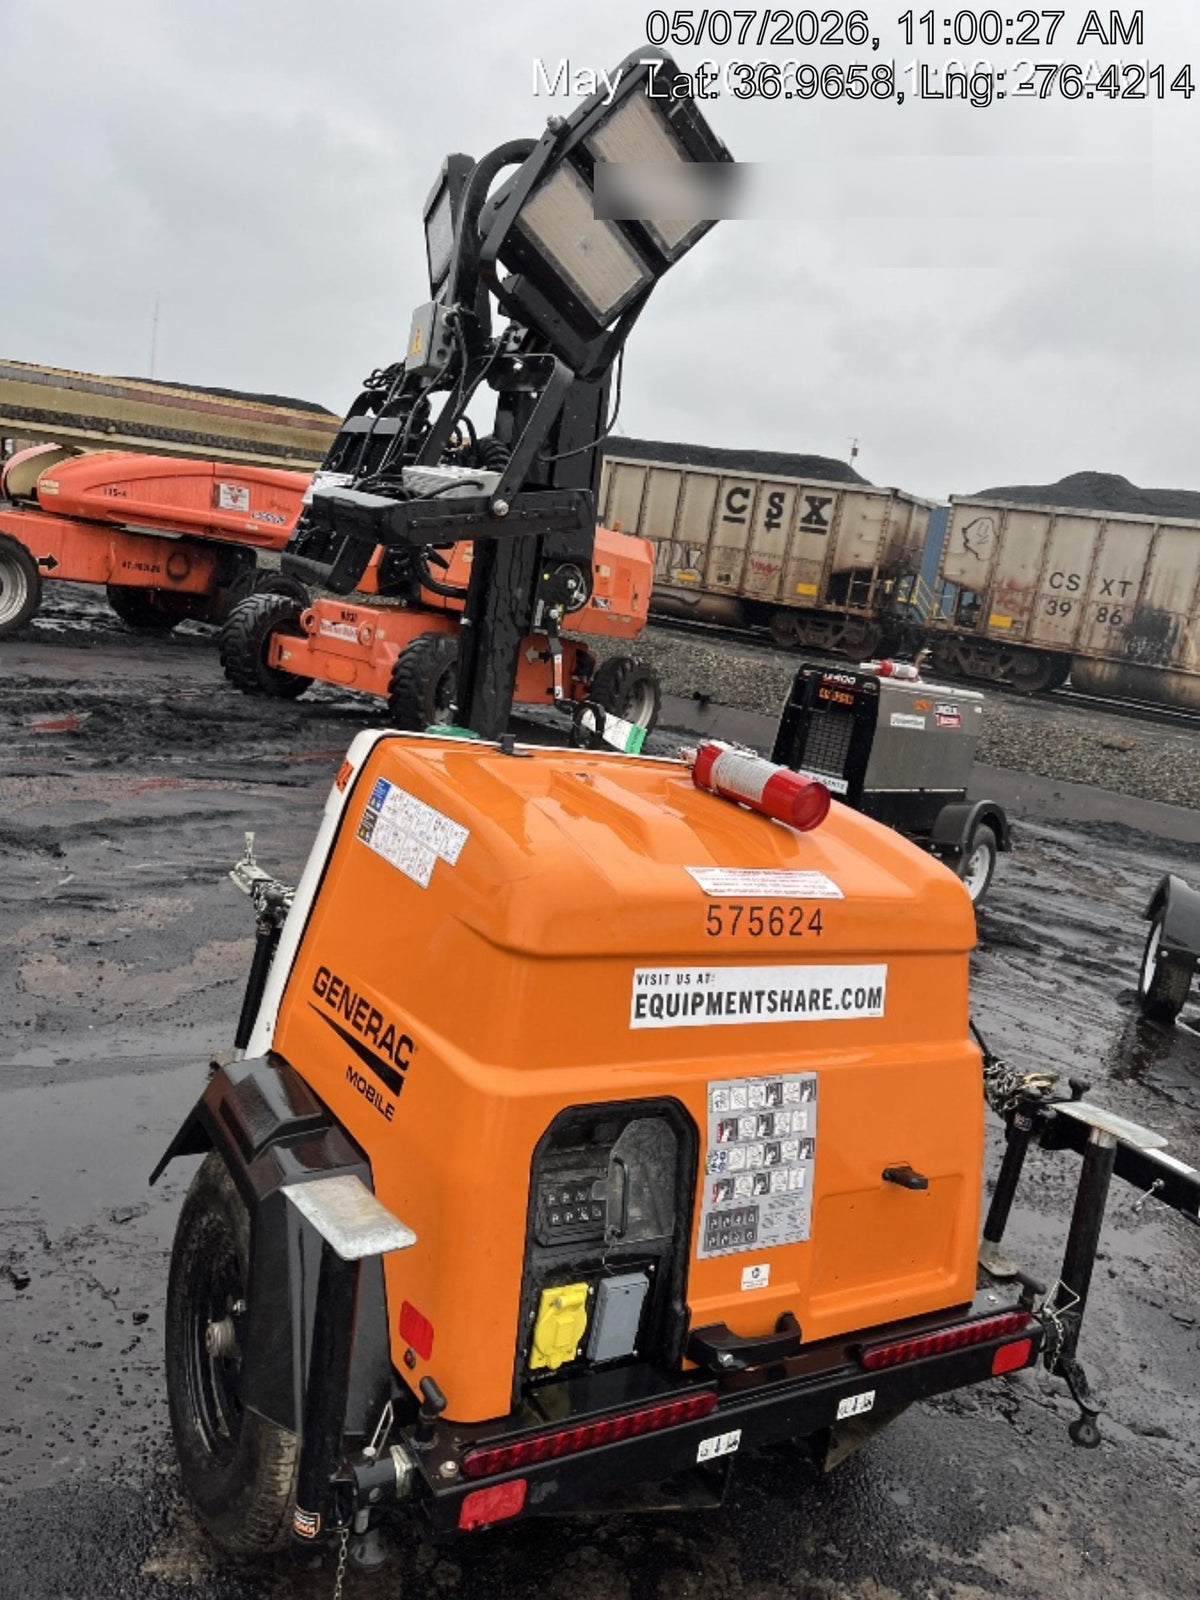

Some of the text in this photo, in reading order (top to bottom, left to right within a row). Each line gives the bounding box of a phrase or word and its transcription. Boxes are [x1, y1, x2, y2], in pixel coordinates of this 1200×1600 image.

[706, 904, 823, 936] 575624
[636, 972, 716, 987] VISIT US AT:
[312, 965, 415, 1072] GENERAC
[634, 986, 883, 1021] EQUIPMENTSHARE.COM
[345, 1064, 396, 1123] MOBILE
